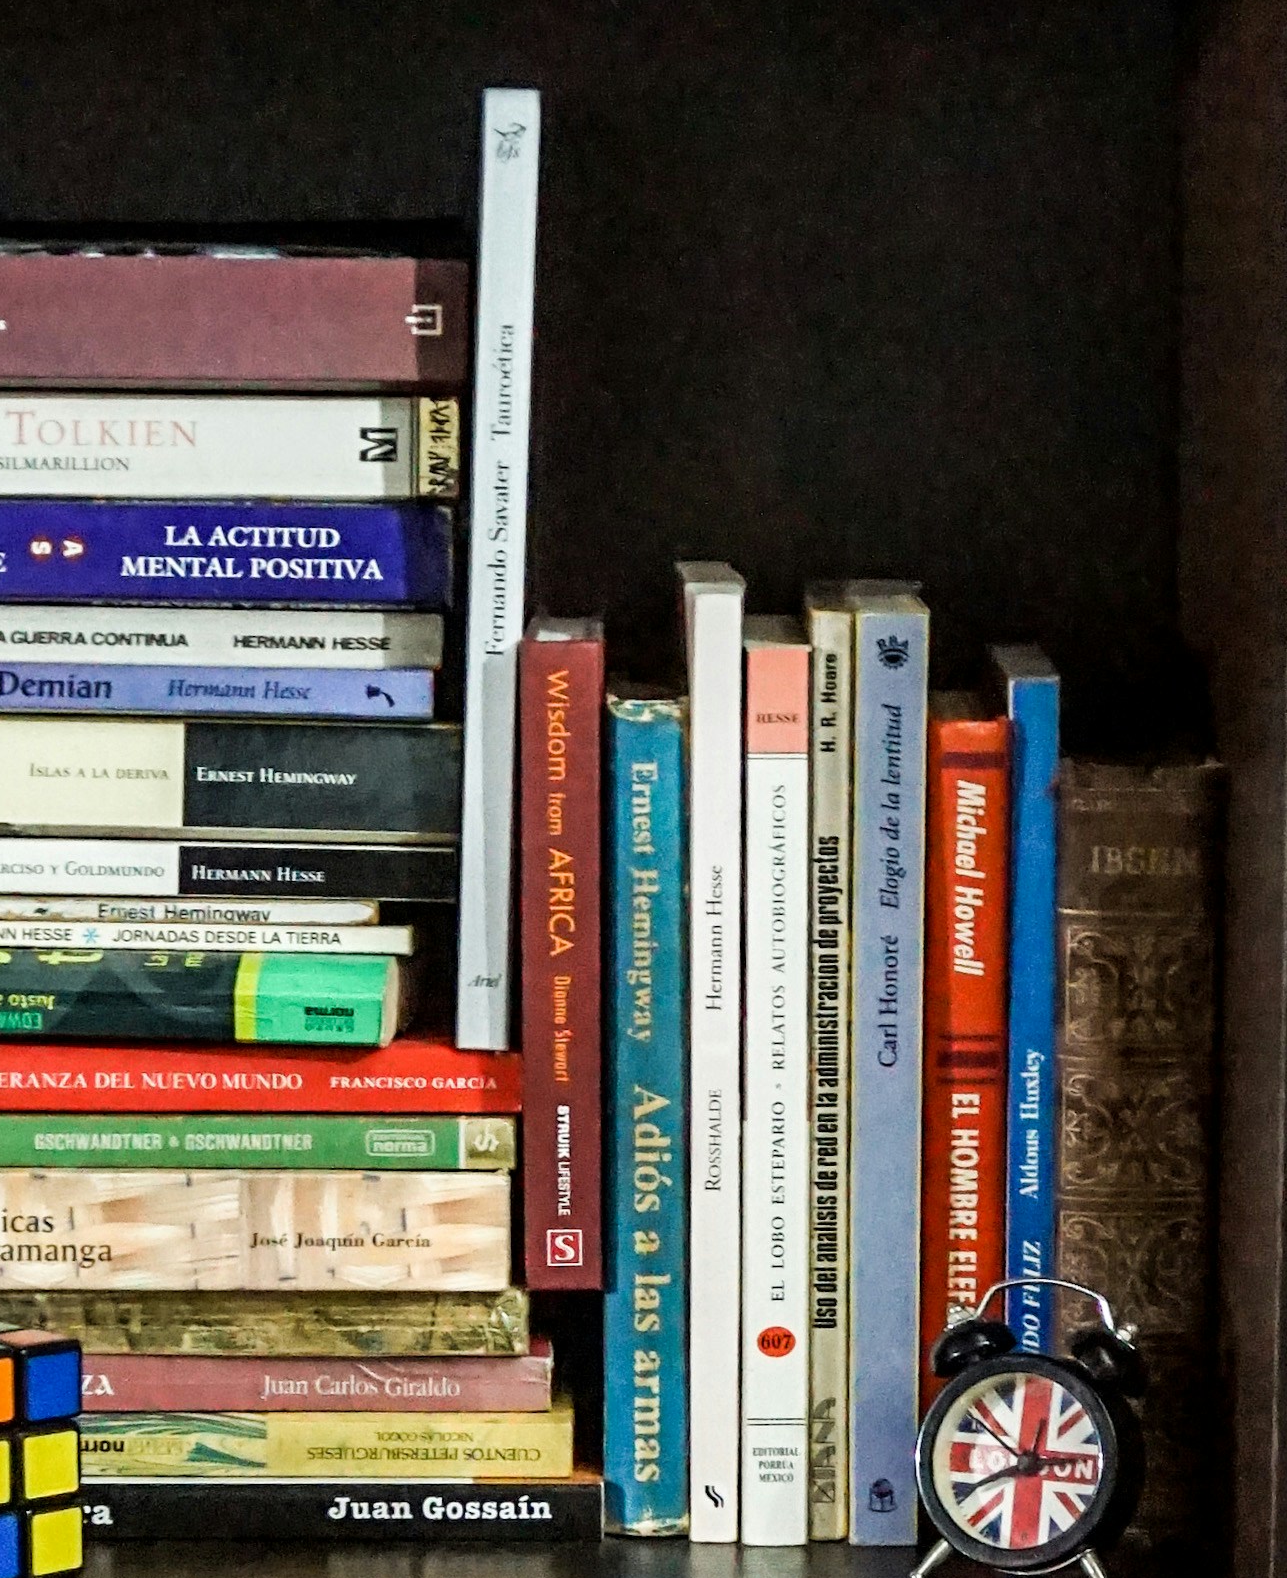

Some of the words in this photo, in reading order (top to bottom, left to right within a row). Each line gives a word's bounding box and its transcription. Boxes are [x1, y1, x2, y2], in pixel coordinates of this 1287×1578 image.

[120, 556, 244, 578] MENTAL
[250, 557, 384, 580] POSITIVA
[165, 525, 203, 546] LA
[208, 526, 341, 548] ACTITUD
[546, 669, 572, 781] Wisdom
[547, 792, 566, 836] from
[631, 761, 658, 858] Ernest
[955, 780, 987, 878] Michael
[548, 848, 576, 957] AFRICA
[953, 885, 984, 976] Howell
[627, 867, 658, 1040] Hemingway
[878, 935, 899, 1016] Honoré
[877, 1023, 898, 1068] Carl
[94, 1072, 134, 1089] DEL
[141, 1072, 217, 1089] NUEVO
[222, 1073, 303, 1090] MUNDO
[634, 1084, 668, 1213] Adiós
[632, 1231, 660, 1254] a
[633, 1274, 668, 1332] las
[757, 1330, 797, 1353] 607
[633, 1350, 661, 1482] armas
[327, 1496, 414, 1520] Juan
[422, 1494, 553, 1520] Gossaín
